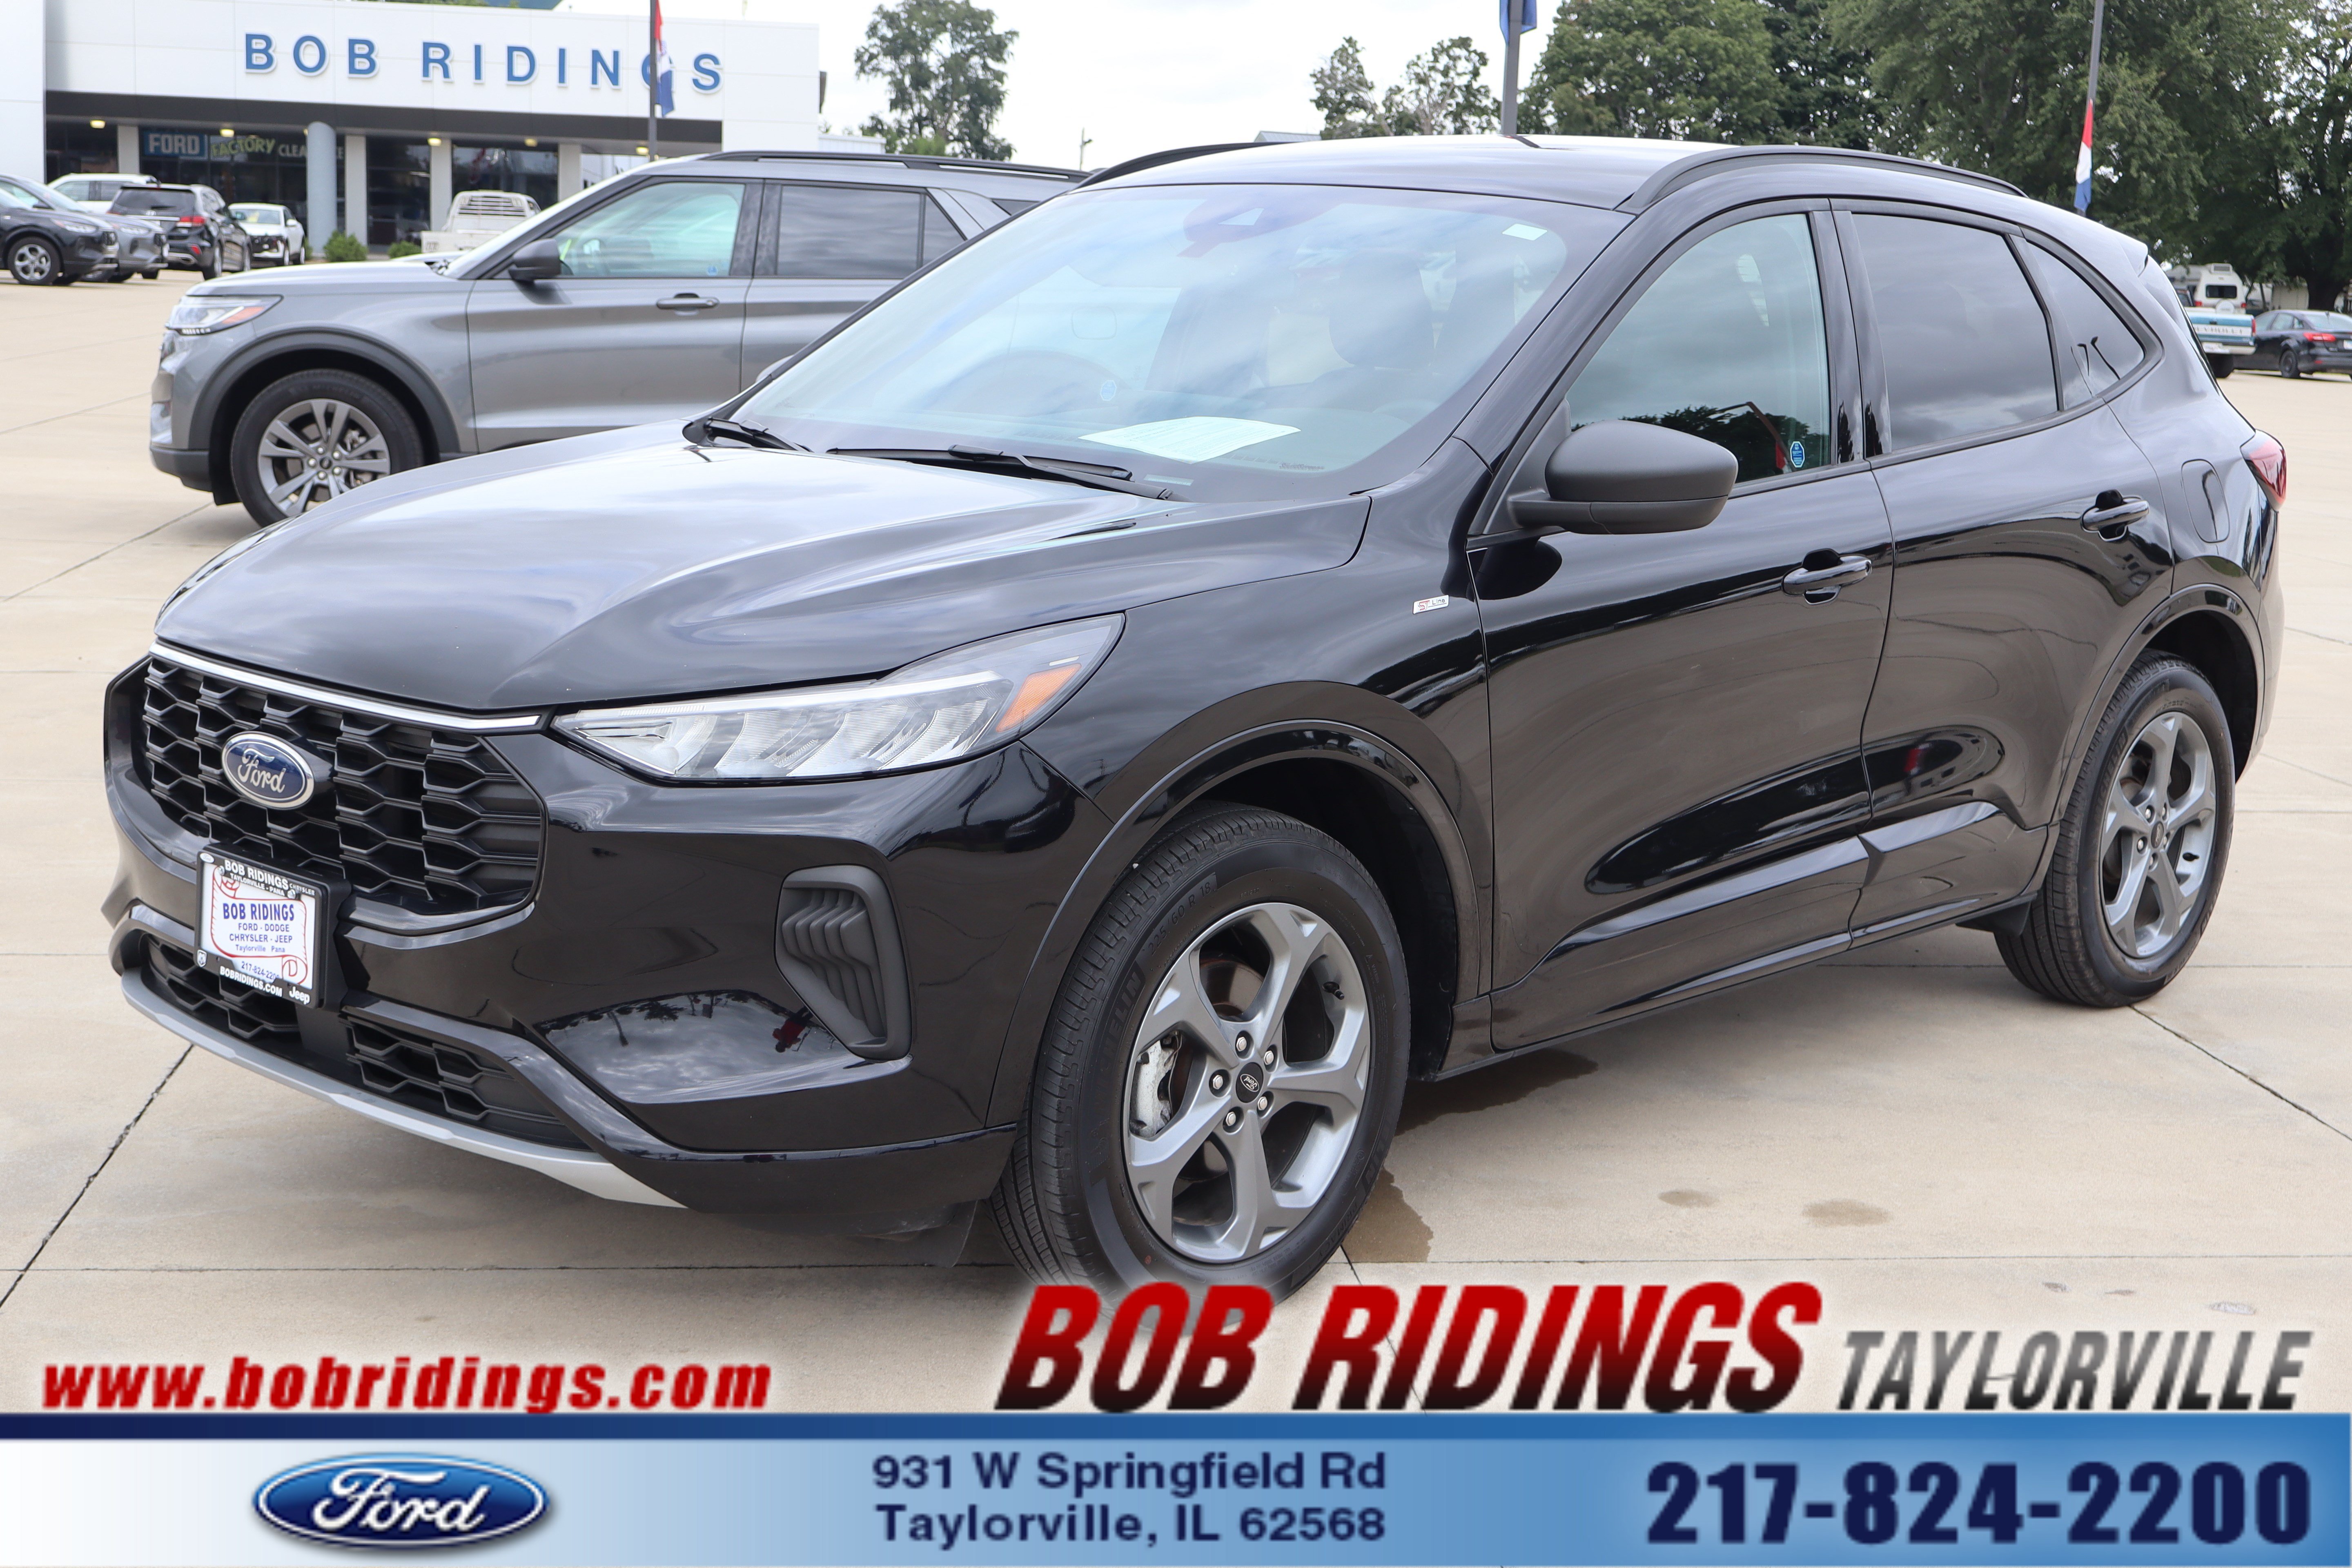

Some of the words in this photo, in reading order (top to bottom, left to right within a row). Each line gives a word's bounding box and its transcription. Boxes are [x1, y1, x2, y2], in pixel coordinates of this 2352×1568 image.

[245, 33, 378, 76] BOB
[149, 133, 200, 155] FORD
[211, 138, 276, 157] FACTORY
[238, 748, 287, 793] Ford
[225, 860, 245, 876] BOB
[247, 867, 289, 891] RIDINGS
[269, 886, 285, 896] PANA
[223, 903, 246, 920] BOB
[251, 903, 294, 921] RIDINGS
[238, 923, 258, 931] FORD
[265, 924, 290, 932] DODGE
[229, 933, 268, 942] CHRYSLER
[275, 935, 293, 943] JEEP
[236, 944, 266, 953] Taylorville
[220, 966, 283, 997] BOBRIDINGS.COM
[289, 986, 310, 1005] Jeep
[1243, 1076, 1258, 1090] Ford
